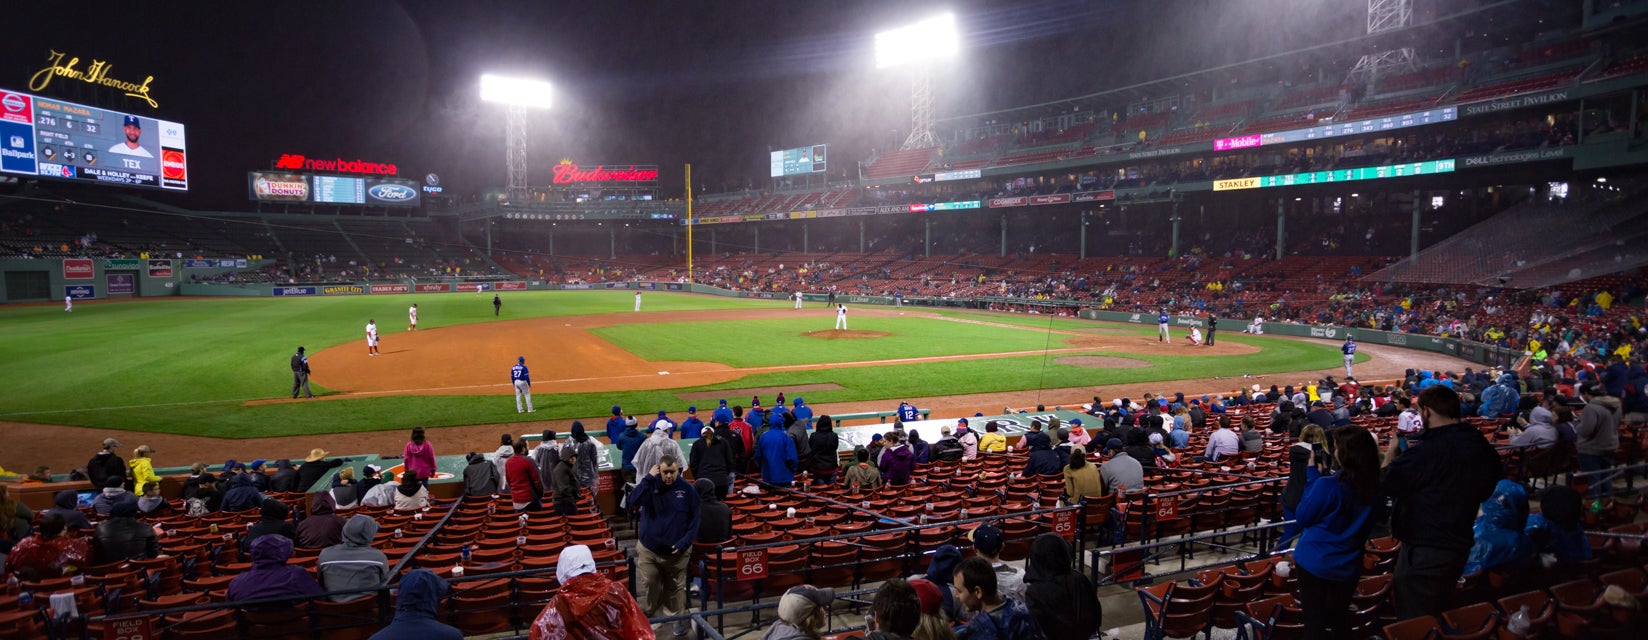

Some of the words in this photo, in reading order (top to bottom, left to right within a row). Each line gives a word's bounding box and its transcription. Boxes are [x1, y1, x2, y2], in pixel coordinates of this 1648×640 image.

[29, 49, 84, 91] John
[84, 59, 158, 108] Hancock
[1467, 106, 1489, 115] STATE
[1491, 100, 1520, 111] STREET
[1524, 92, 1567, 106] PAVILION
[86, 125, 96, 133] 32
[1, 148, 34, 159] Ballpark
[1465, 156, 1488, 165] DELL
[1489, 152, 1539, 164] Technologies
[1541, 148, 1564, 158] Level
[123, 158, 141, 169] TEX
[1439, 161, 1455, 170] 9TH
[84, 168, 101, 176] DALE
[553, 163, 659, 184] Budweiser
[1219, 180, 1255, 189] STANLEY
[271, 188, 304, 196] DONUTS
[378, 187, 406, 199] Ford
[283, 287, 307, 296] jetBlue
[325, 286, 349, 294] GRANITE
[350, 285, 363, 293] CITY
[513, 370, 522, 378] 27
[904, 410, 914, 420] 12
[1158, 507, 1173, 517] 64
[1055, 522, 1071, 532] 65
[741, 563, 763, 575] 66
[112, 620, 143, 629] FIELD
[117, 627, 139, 635] BOX
